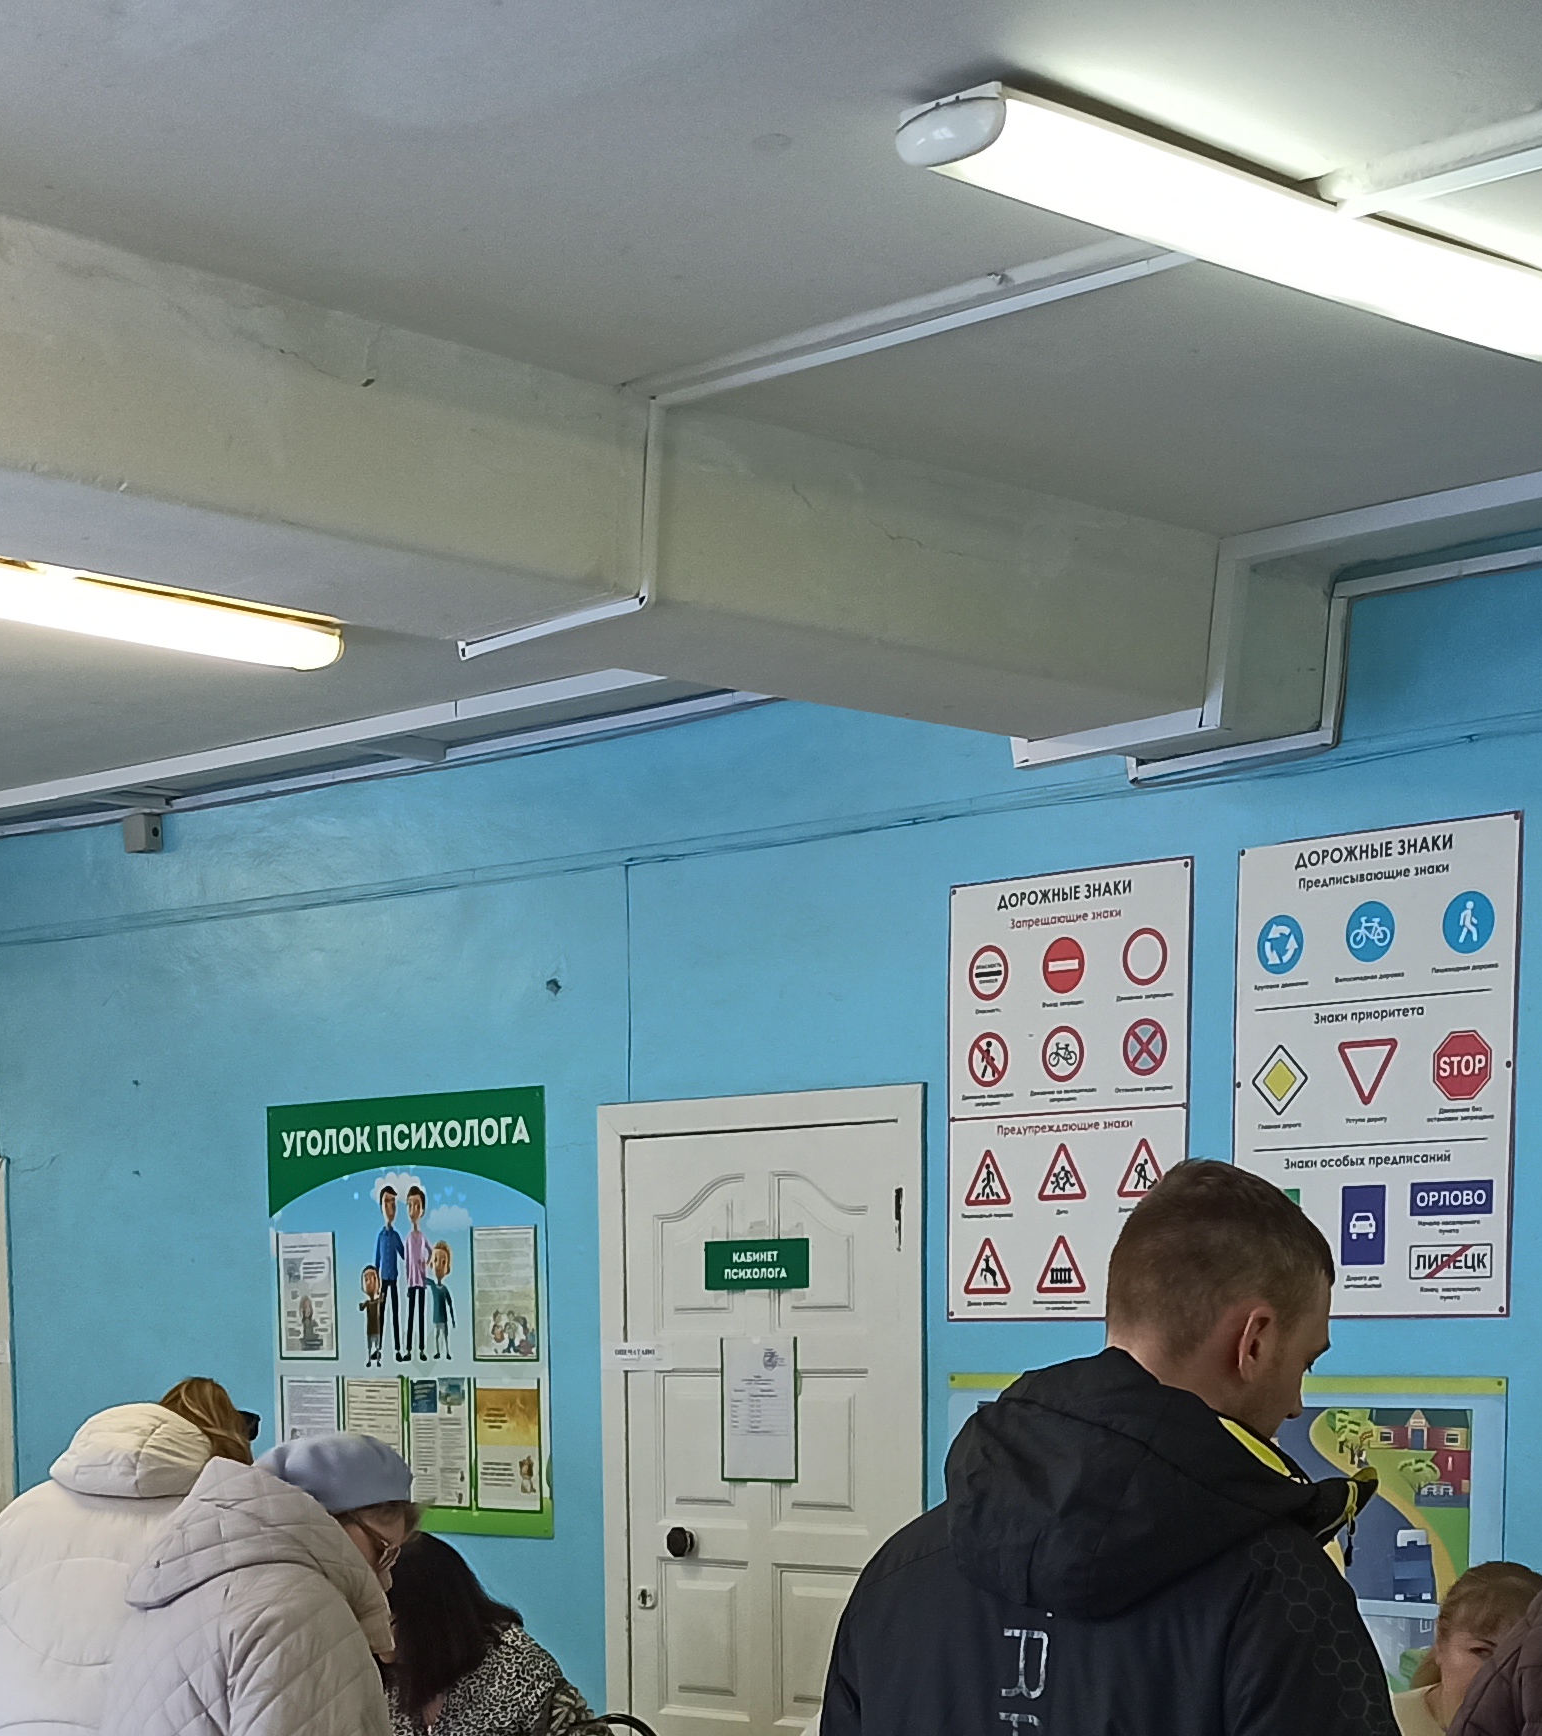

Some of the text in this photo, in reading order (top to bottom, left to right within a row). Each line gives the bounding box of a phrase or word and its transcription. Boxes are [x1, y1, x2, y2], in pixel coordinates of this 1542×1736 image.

[1294, 833, 1454, 870] ДОРОЖНЫЕ ЗНАКИ
[1298, 862, 1450, 892] Предписывающие знаки
[997, 879, 1133, 912] ДОРОЖНЫЕ ЗНАКИ
[1010, 908, 1122, 930] Запрещающие знаки
[1313, 1004, 1425, 1025] Знаки приоритета
[1439, 1054, 1486, 1077] STOP
[281, 1115, 531, 1158] УГОЛОК ПСИХОЛОГА
[997, 1119, 1134, 1137] Предупреждающие знаки
[1284, 1150, 1452, 1170] Знаки особых предписаний
[1416, 1189, 1487, 1207] ОРЛОВО
[732, 1250, 779, 1264] КАБИНЕТ
[1414, 1252, 1488, 1272] ЛИПЕЦК
[724, 1267, 788, 1281] ПСИХОЛОГА
